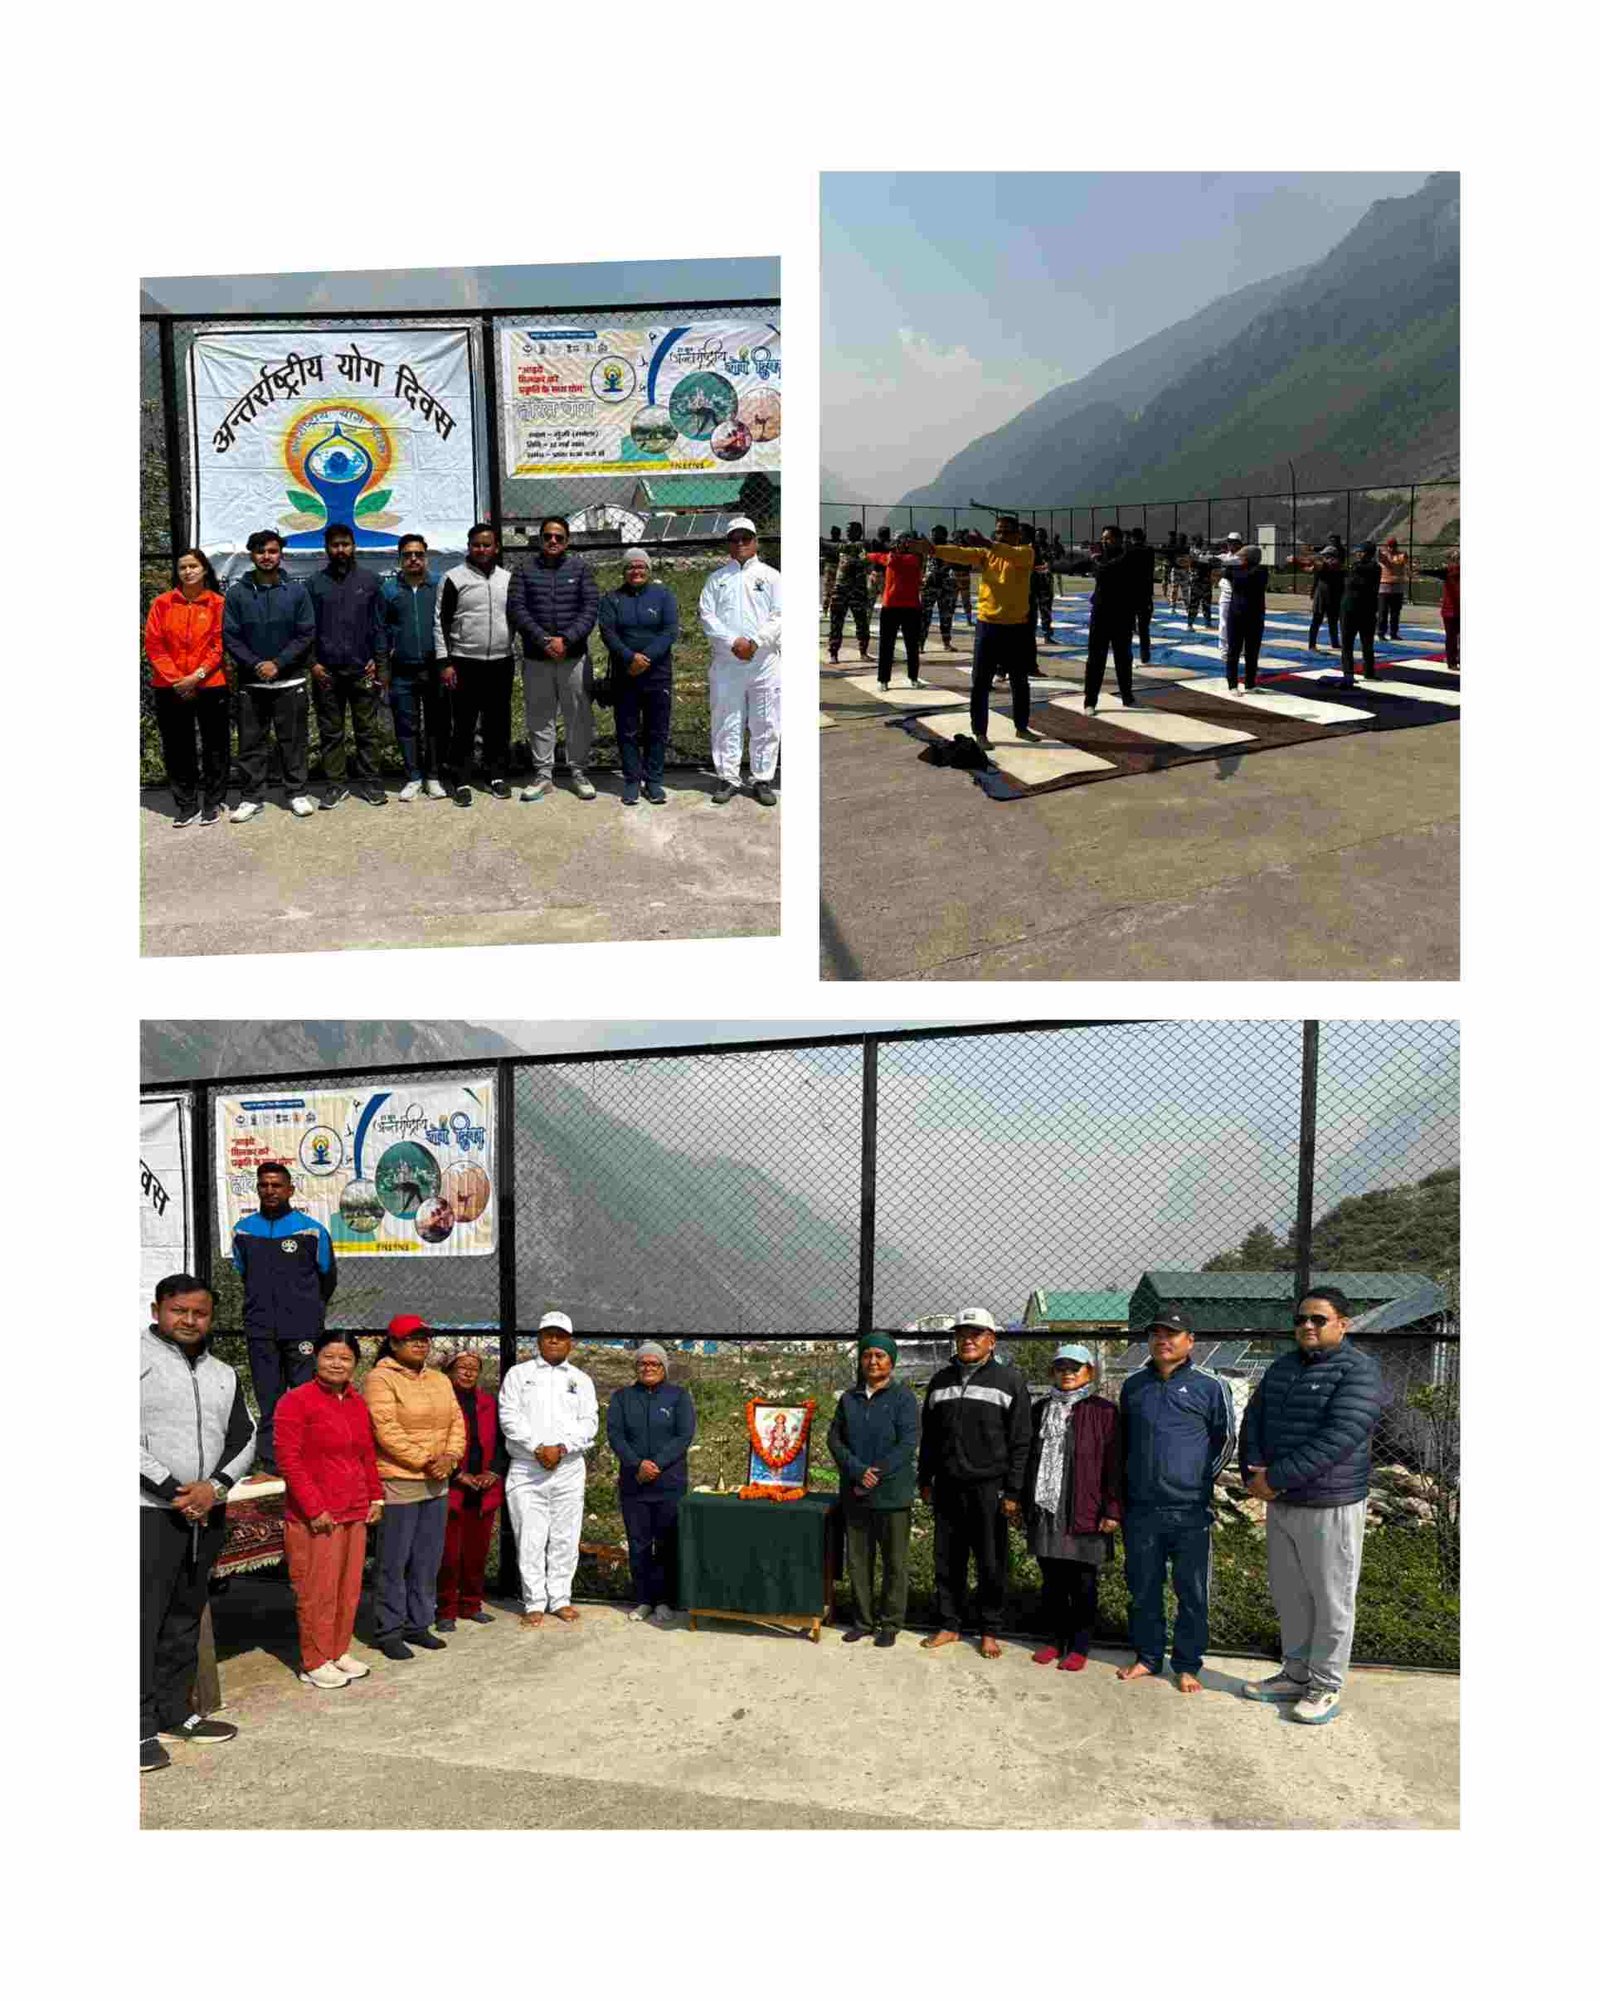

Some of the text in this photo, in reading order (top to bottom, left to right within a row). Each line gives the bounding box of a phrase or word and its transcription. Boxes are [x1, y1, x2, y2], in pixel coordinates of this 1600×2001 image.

[335, 343, 384, 387] योग
[394, 364, 457, 440] दिवस
[140, 1158, 170, 1217] वस
